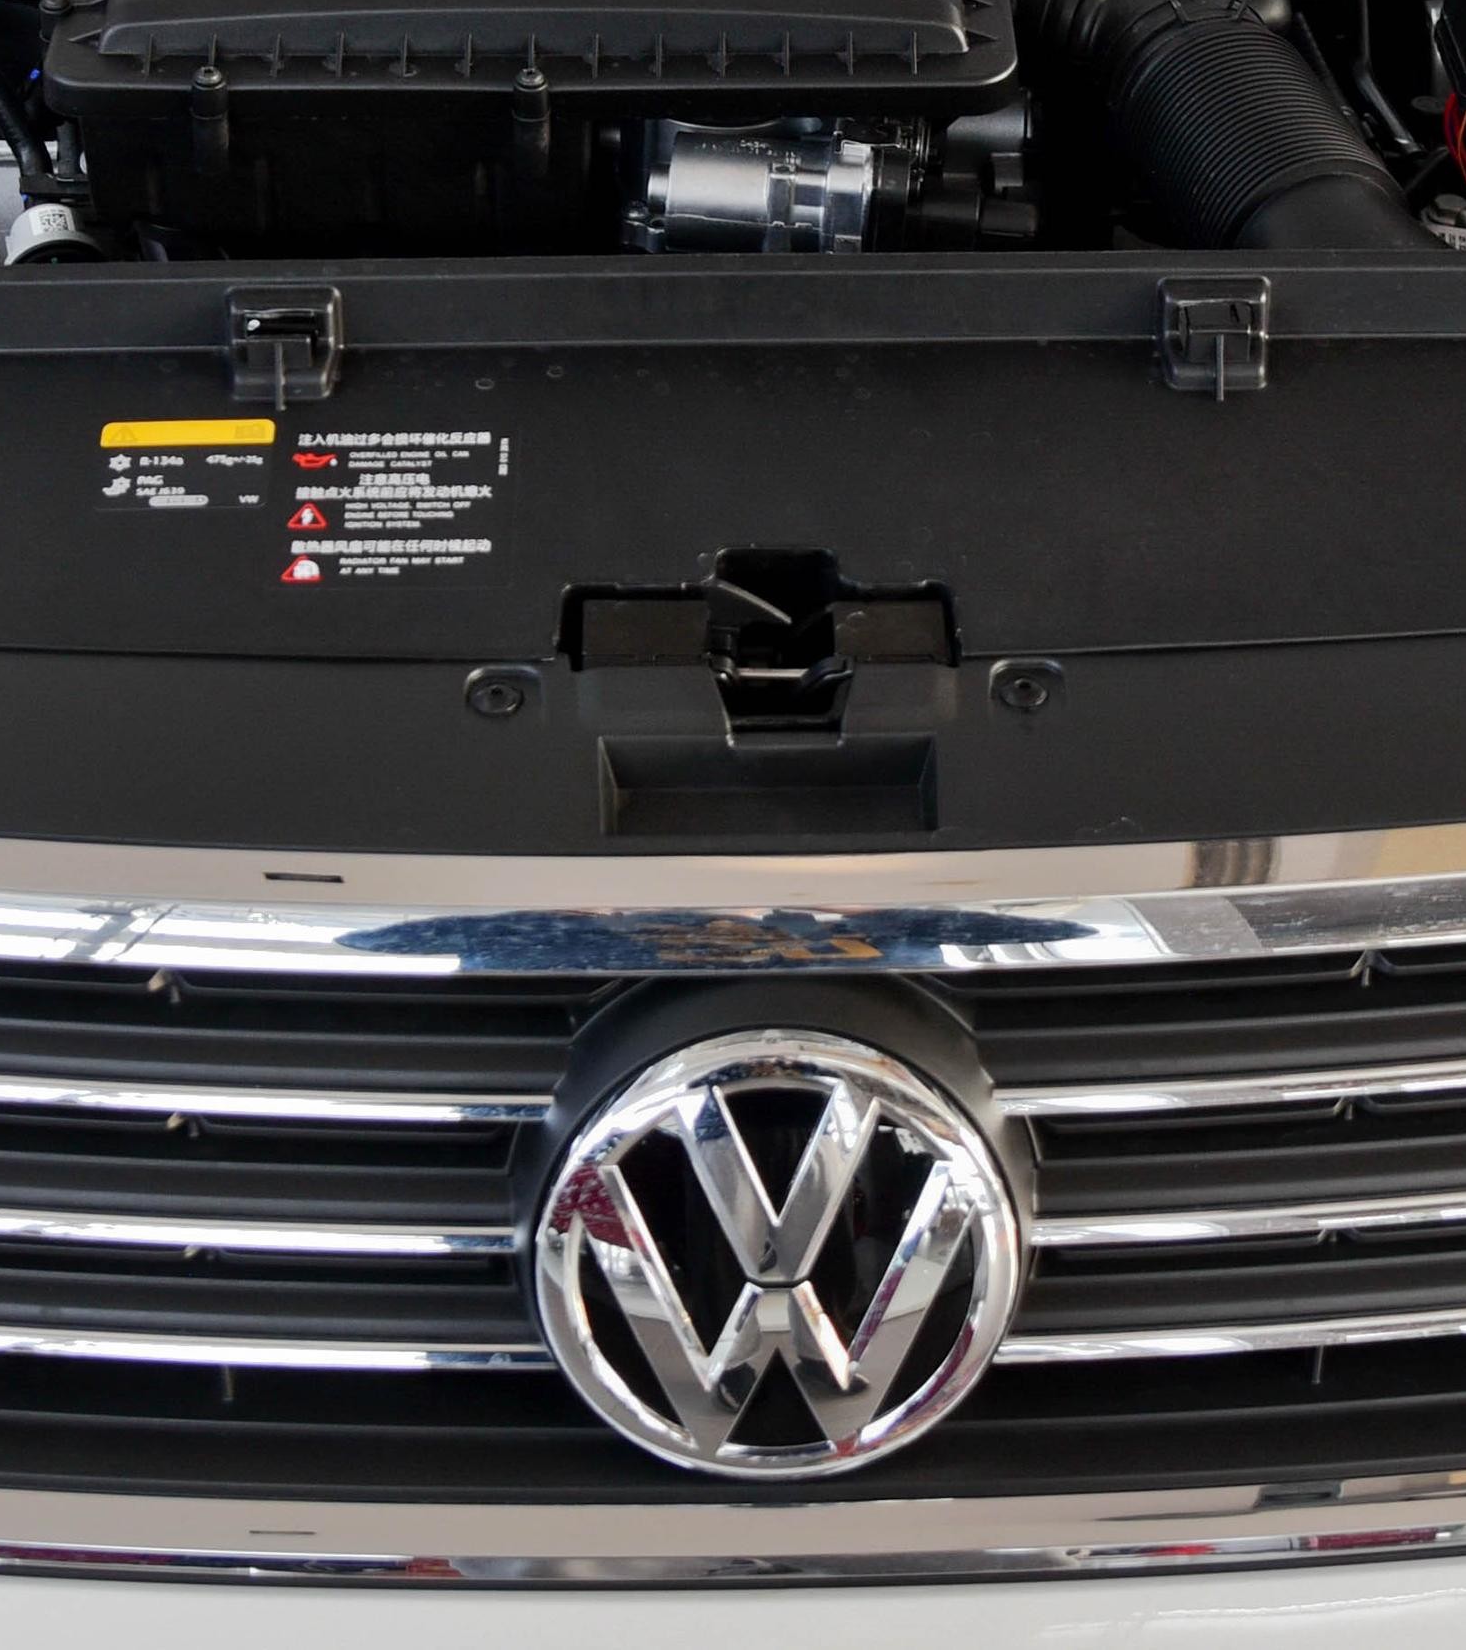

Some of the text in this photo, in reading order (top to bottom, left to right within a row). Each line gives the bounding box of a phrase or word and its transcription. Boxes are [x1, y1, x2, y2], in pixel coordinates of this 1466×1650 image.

[400, 451, 430, 459] ENGINE
[339, 557, 387, 565] RADIATOR
[434, 556, 465, 565] START
[555, 1053, 997, 1468] VW
